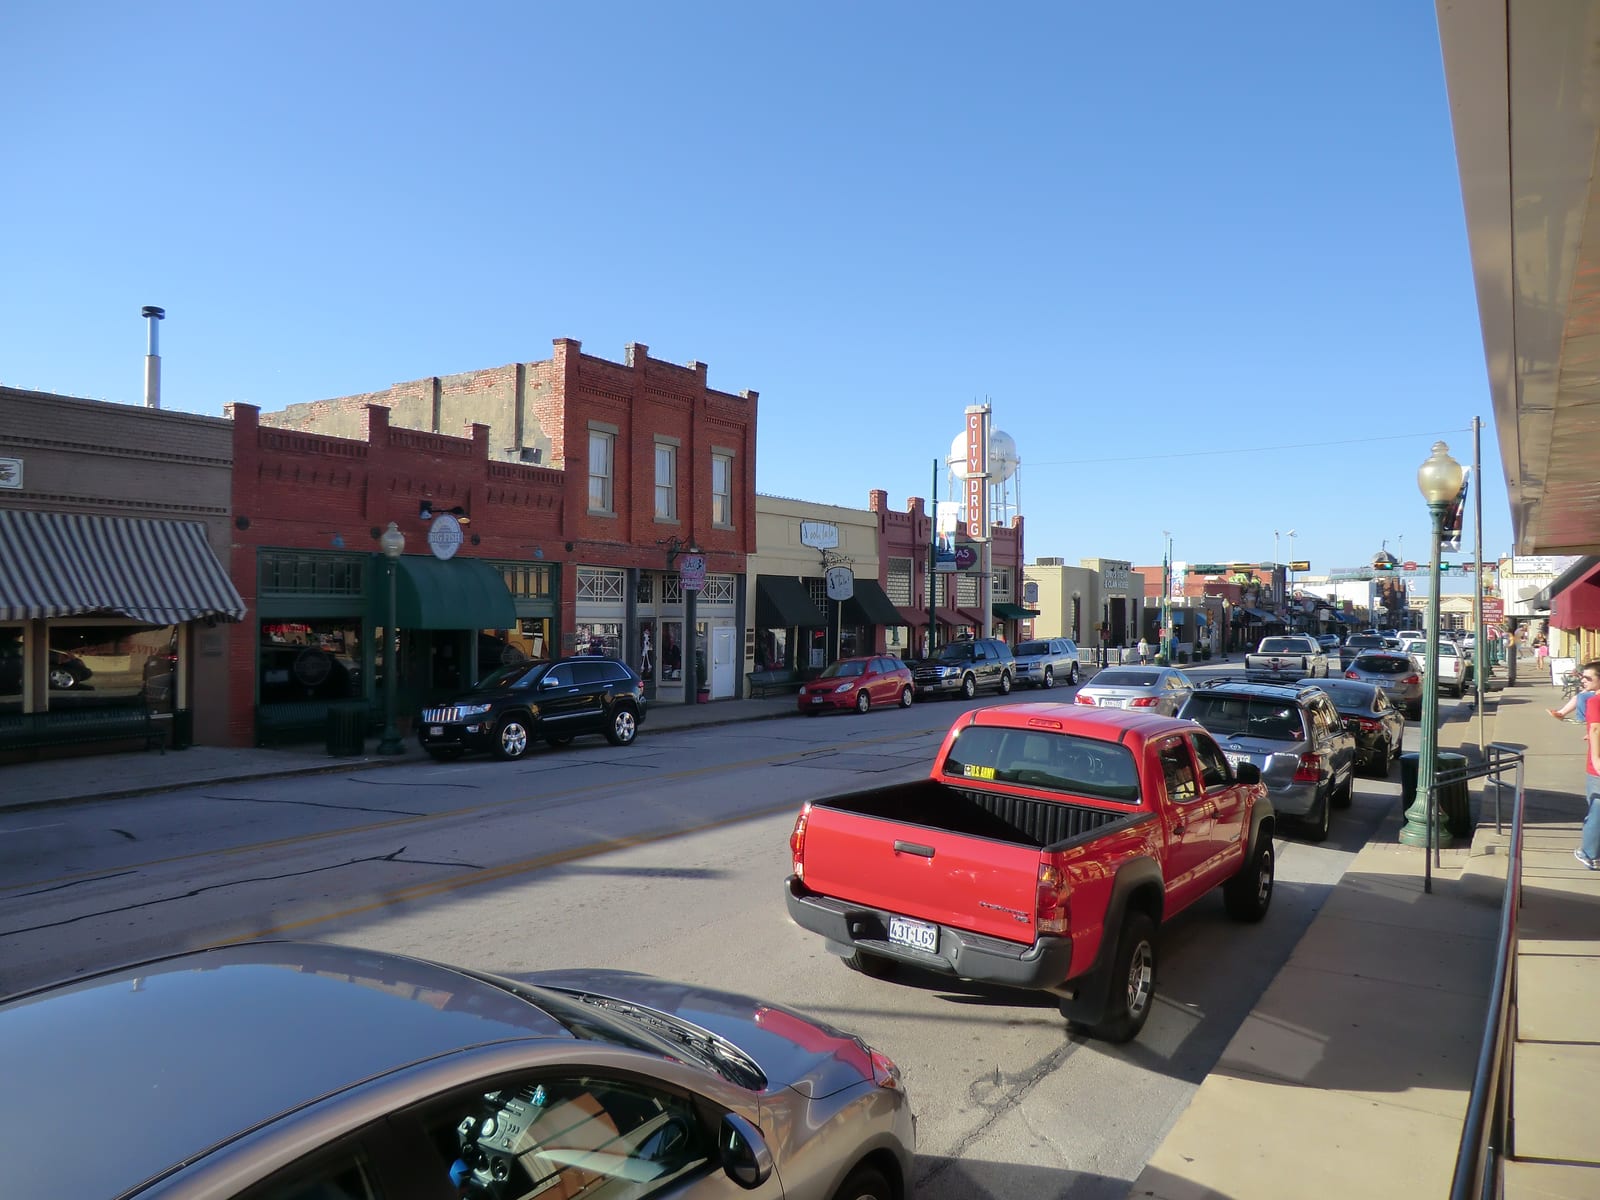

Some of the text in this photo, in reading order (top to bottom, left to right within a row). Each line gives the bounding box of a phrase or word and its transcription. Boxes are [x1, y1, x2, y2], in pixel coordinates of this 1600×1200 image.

[969, 415, 980, 536] CITY DRUG
[444, 532, 461, 543] FISH
[981, 766, 995, 779] ARMY
